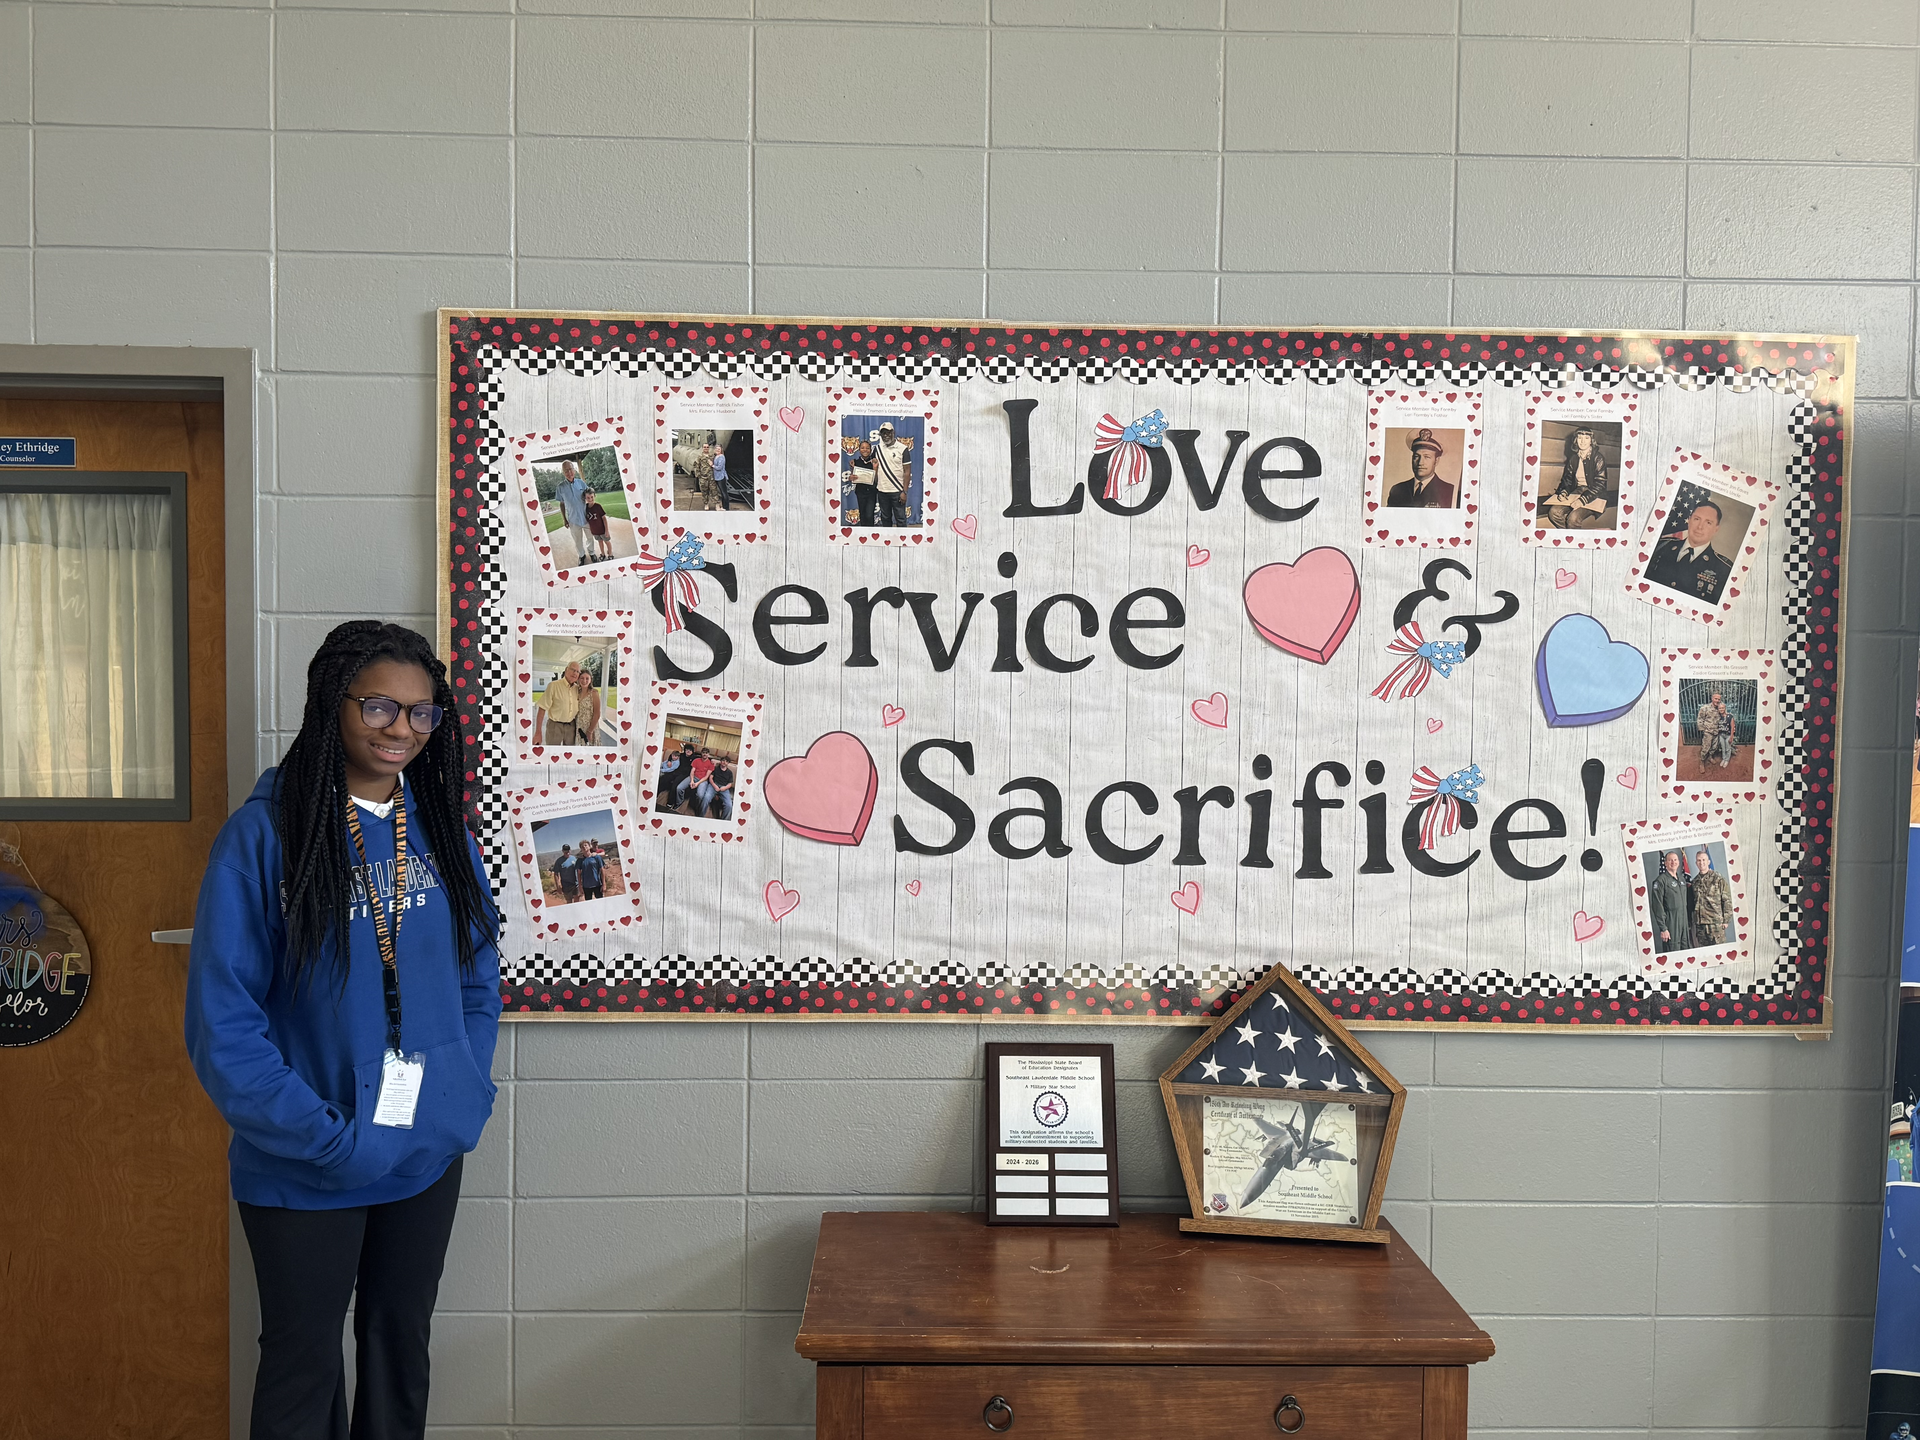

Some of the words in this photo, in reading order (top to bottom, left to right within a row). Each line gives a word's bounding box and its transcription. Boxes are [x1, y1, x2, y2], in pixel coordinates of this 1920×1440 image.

[0, 444, 13, 453] ey
[16, 442, 60, 455] Ethridge
[575, 442, 601, 450] Grandfather
[1003, 399, 1322, 521] Love
[1697, 472, 1711, 481] Service
[1730, 490, 1741, 498] Uncle
[650, 551, 1186, 681] Service
[1393, 558, 1520, 658] &
[545, 806, 572, 814] Whitehead's
[893, 738, 1605, 881] Sacrifice!
[349, 893, 425, 920] TIERS
[0, 910, 43, 948] rs.
[0, 947, 81, 995] RIDGE
[0, 991, 48, 1016] elor
